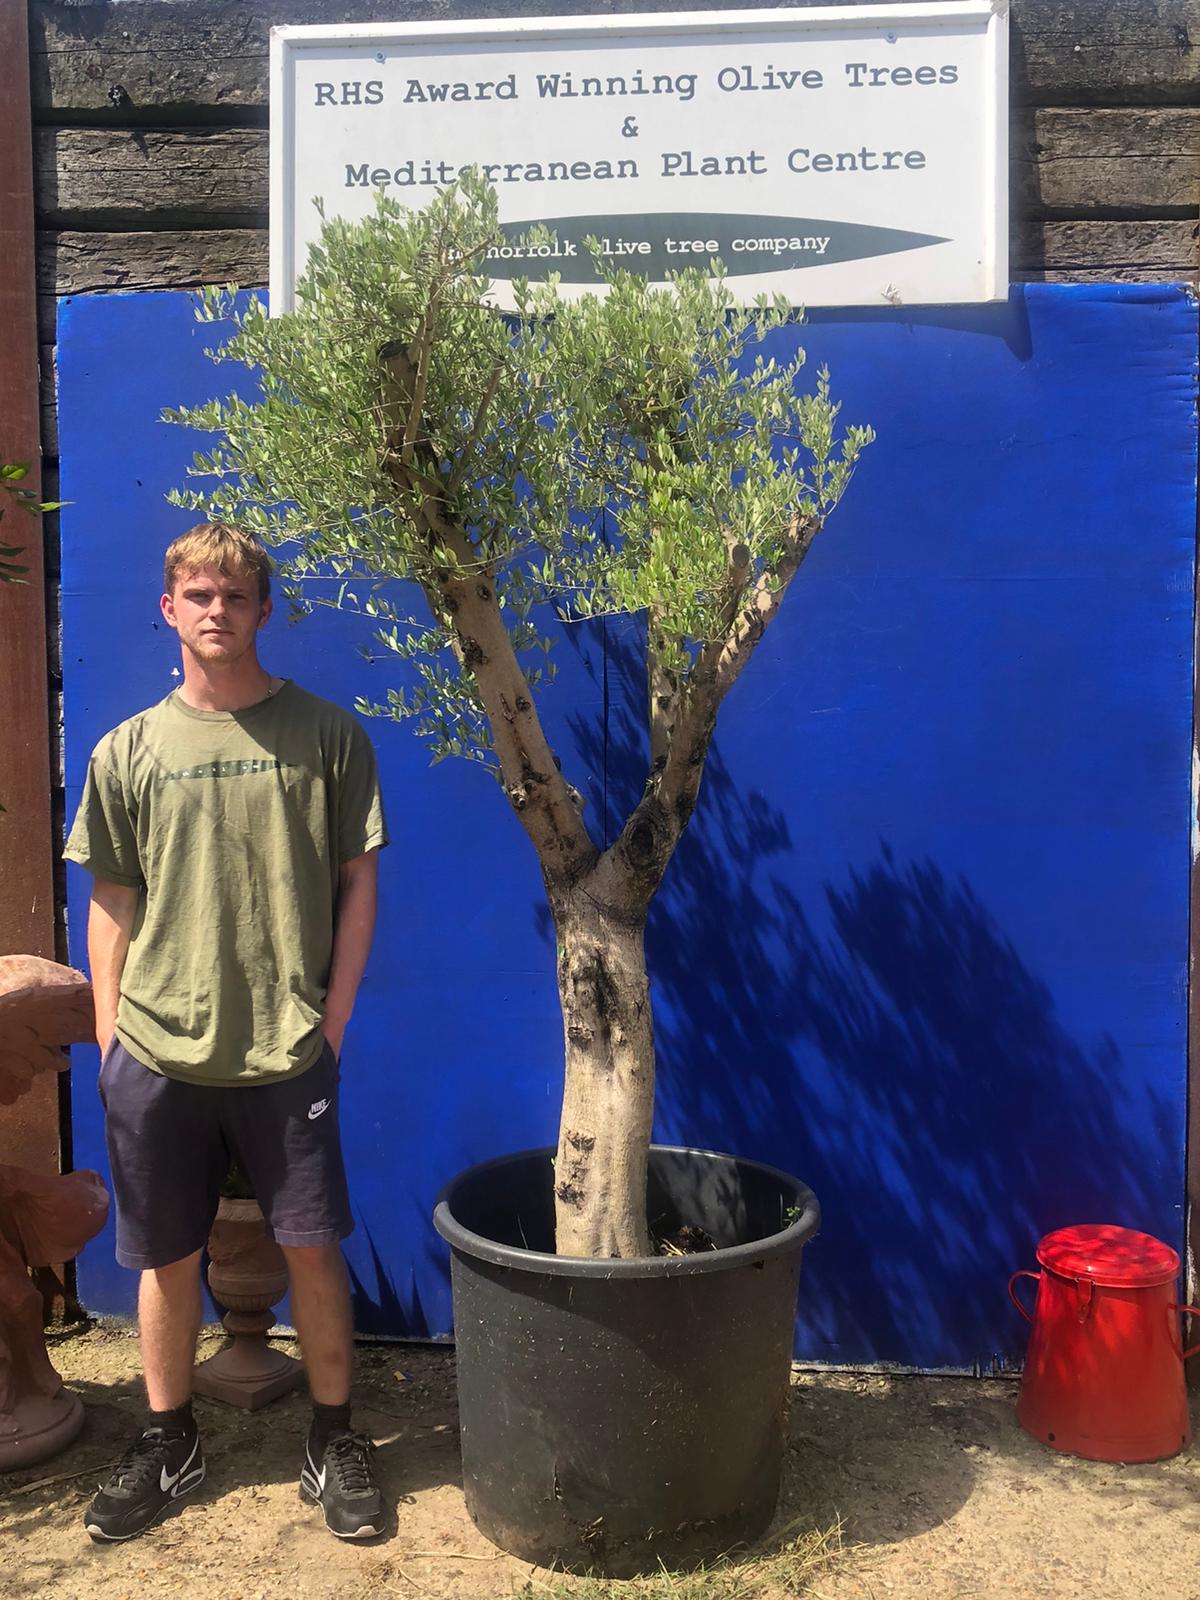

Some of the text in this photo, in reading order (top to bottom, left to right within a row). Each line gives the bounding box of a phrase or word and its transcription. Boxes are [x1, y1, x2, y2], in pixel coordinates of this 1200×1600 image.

[315, 63, 959, 106] RHS Award Winning Olive Trees
[621, 116, 639, 138] &
[661, 150, 768, 177] Plant
[787, 147, 926, 174] Centre
[486, 237, 831, 258] norfolk live tree company
